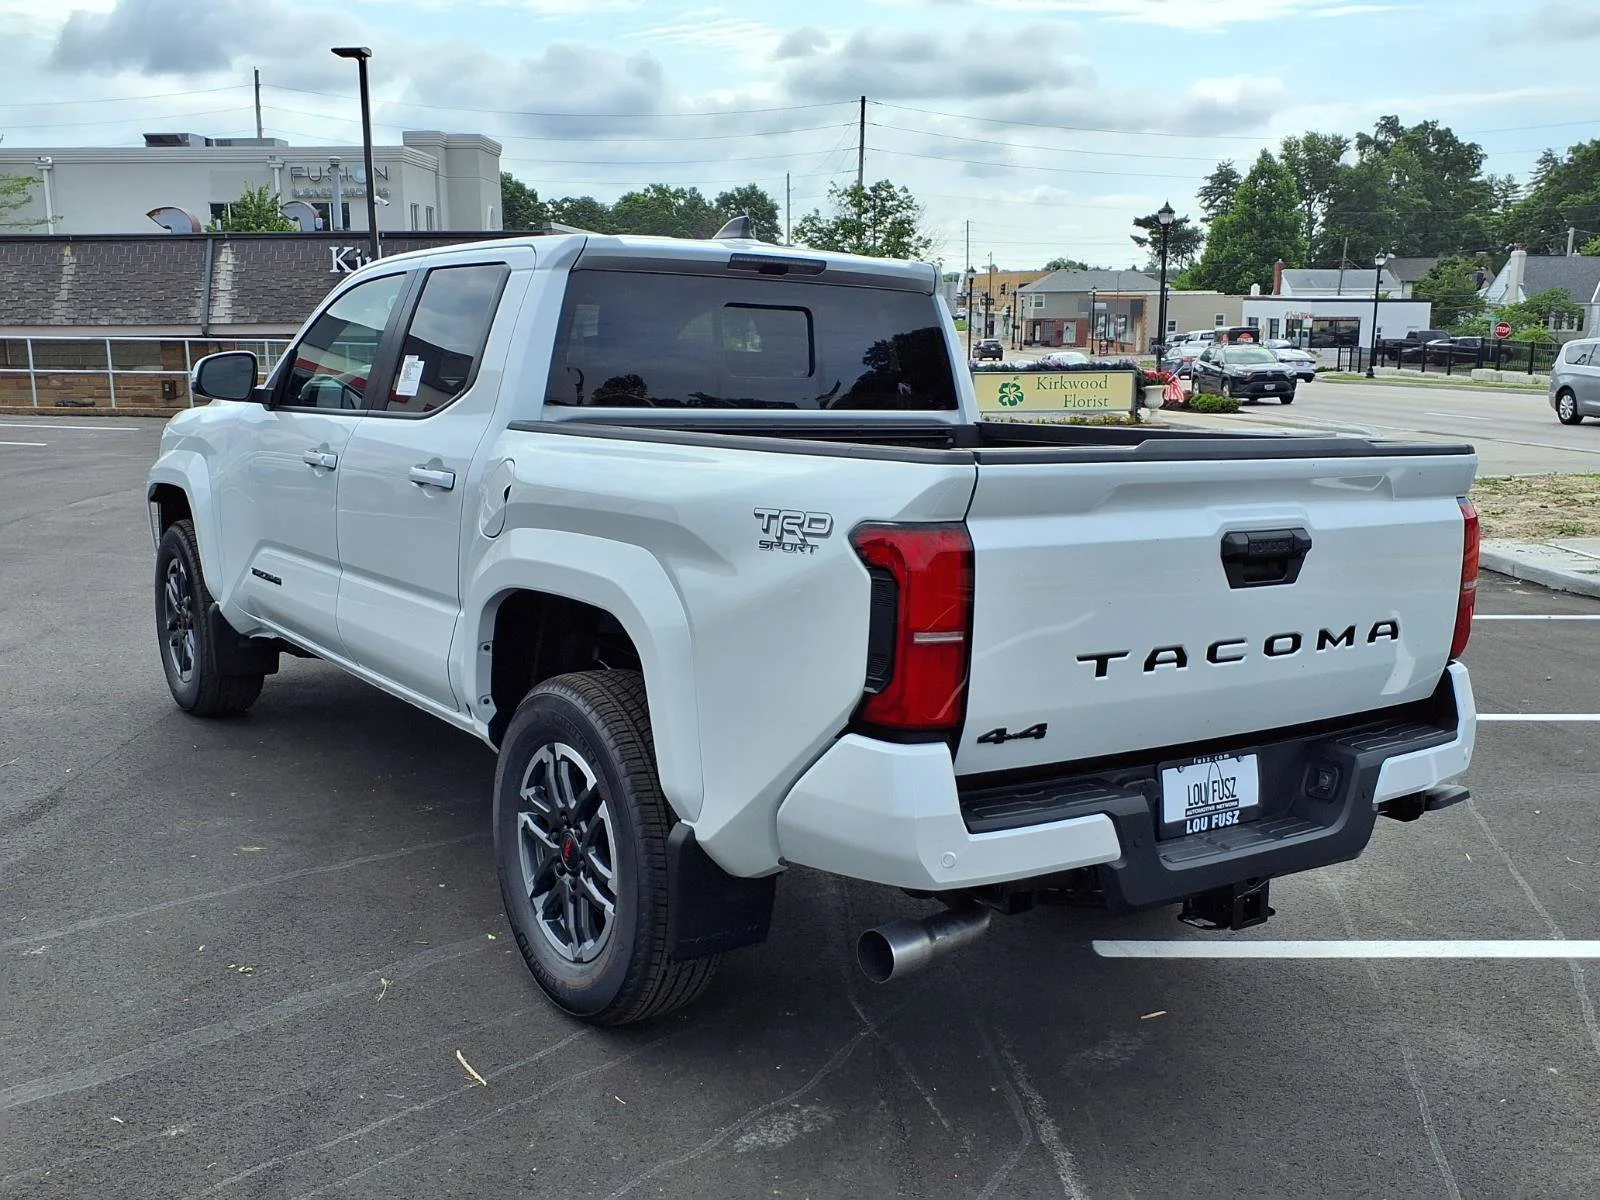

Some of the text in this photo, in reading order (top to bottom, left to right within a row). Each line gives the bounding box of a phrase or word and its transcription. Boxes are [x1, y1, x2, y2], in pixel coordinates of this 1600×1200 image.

[1036, 375, 1108, 390] Kirkwood
[1064, 394, 1109, 408] Florist
[754, 507, 834, 542] TRD
[758, 540, 820, 555] SPORT
[1075, 619, 1400, 680] TACOMA
[1193, 754, 1230, 763] fusz.com
[1187, 777, 1236, 806] LOU FUSZ
[1186, 801, 1238, 815] AUTOMOTIVE NETWORK
[1186, 810, 1240, 834] LOU FUSZ
